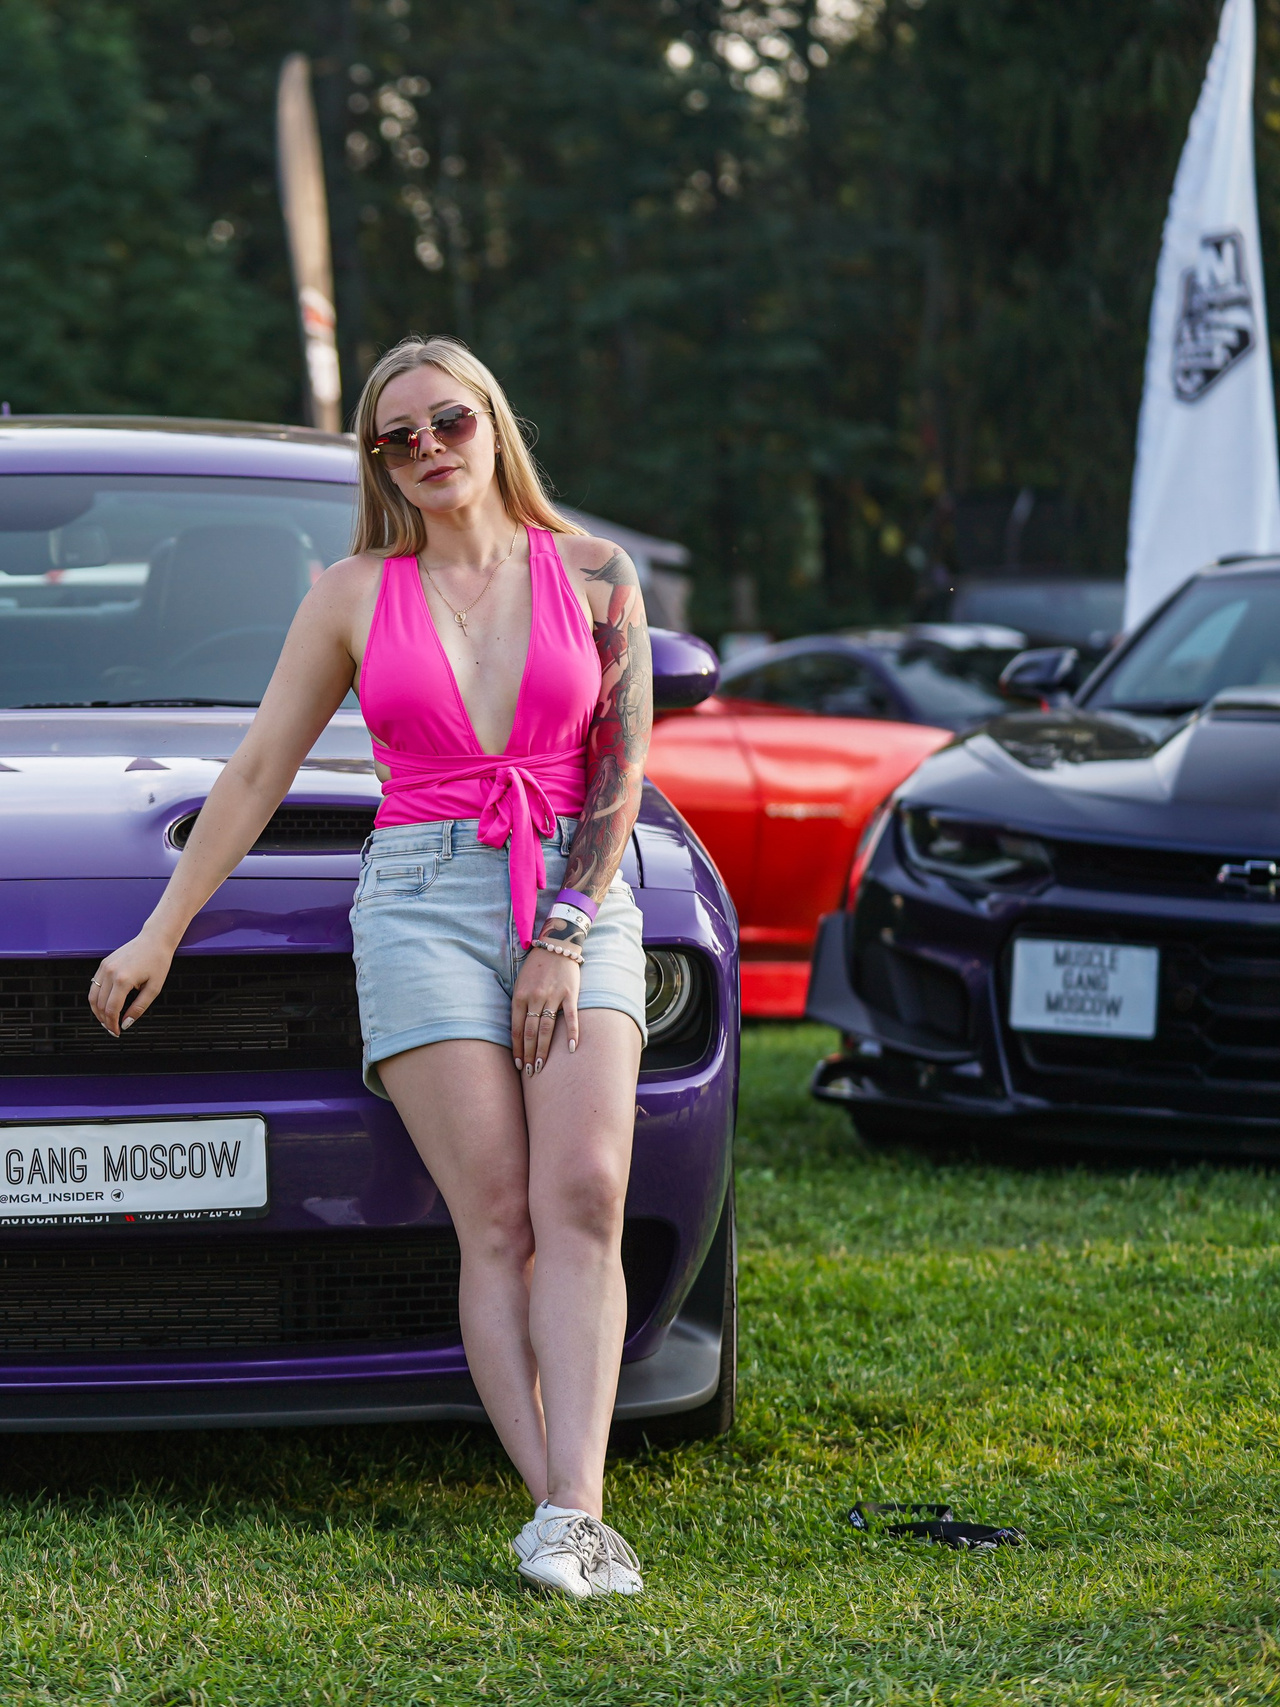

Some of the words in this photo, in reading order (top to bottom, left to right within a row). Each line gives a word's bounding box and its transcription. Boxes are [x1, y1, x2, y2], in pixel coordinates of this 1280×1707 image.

[1053, 943, 1119, 972] MUSCLE
[1062, 967, 1109, 992] GANG
[1045, 990, 1124, 1018] MOSCOW
[4, 1146, 88, 1185] GANG
[103, 1140, 242, 1182] MOSCOW
